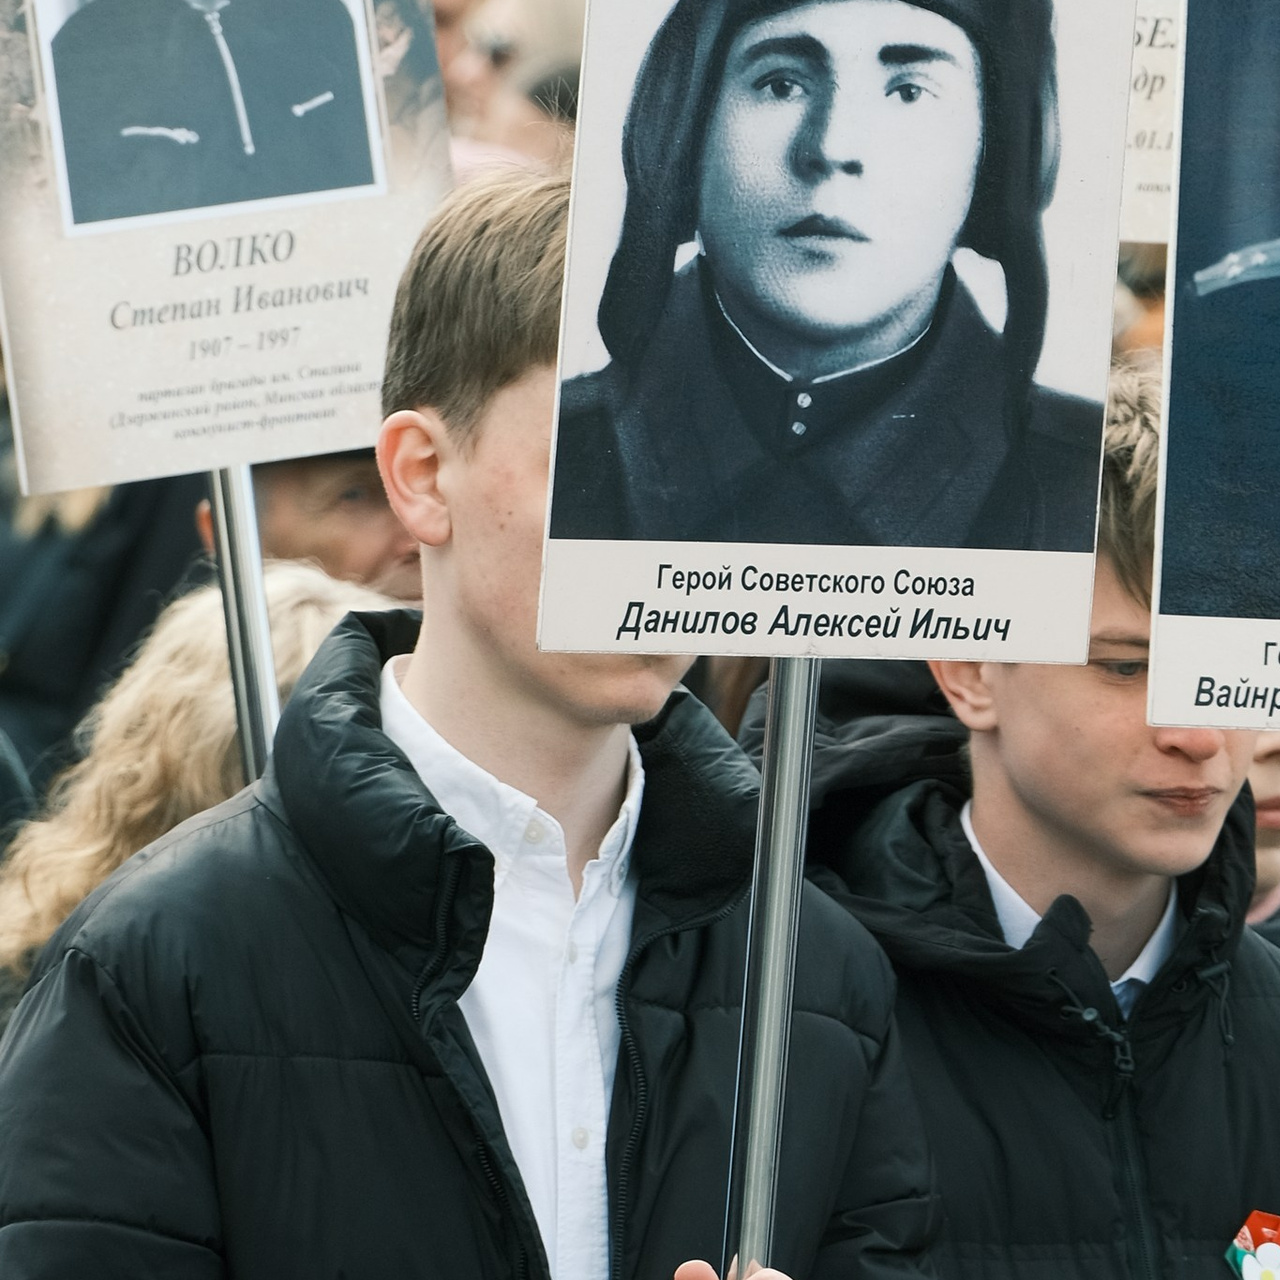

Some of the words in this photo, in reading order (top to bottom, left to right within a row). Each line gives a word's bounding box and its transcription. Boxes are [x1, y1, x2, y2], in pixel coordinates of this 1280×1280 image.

[171, 229, 295, 277] ВОЛКО
[110, 298, 221, 330] Степан
[232, 277, 369, 314] Иванович
[190, 335, 233, 361] 1907
[256, 327, 301, 352] 1997
[657, 563, 732, 595] Герой
[740, 565, 885, 595] Советского
[893, 569, 975, 597] Союза
[616, 601, 757, 641] Данилов
[767, 606, 901, 638] Алексей
[908, 607, 1011, 642] Ильич
